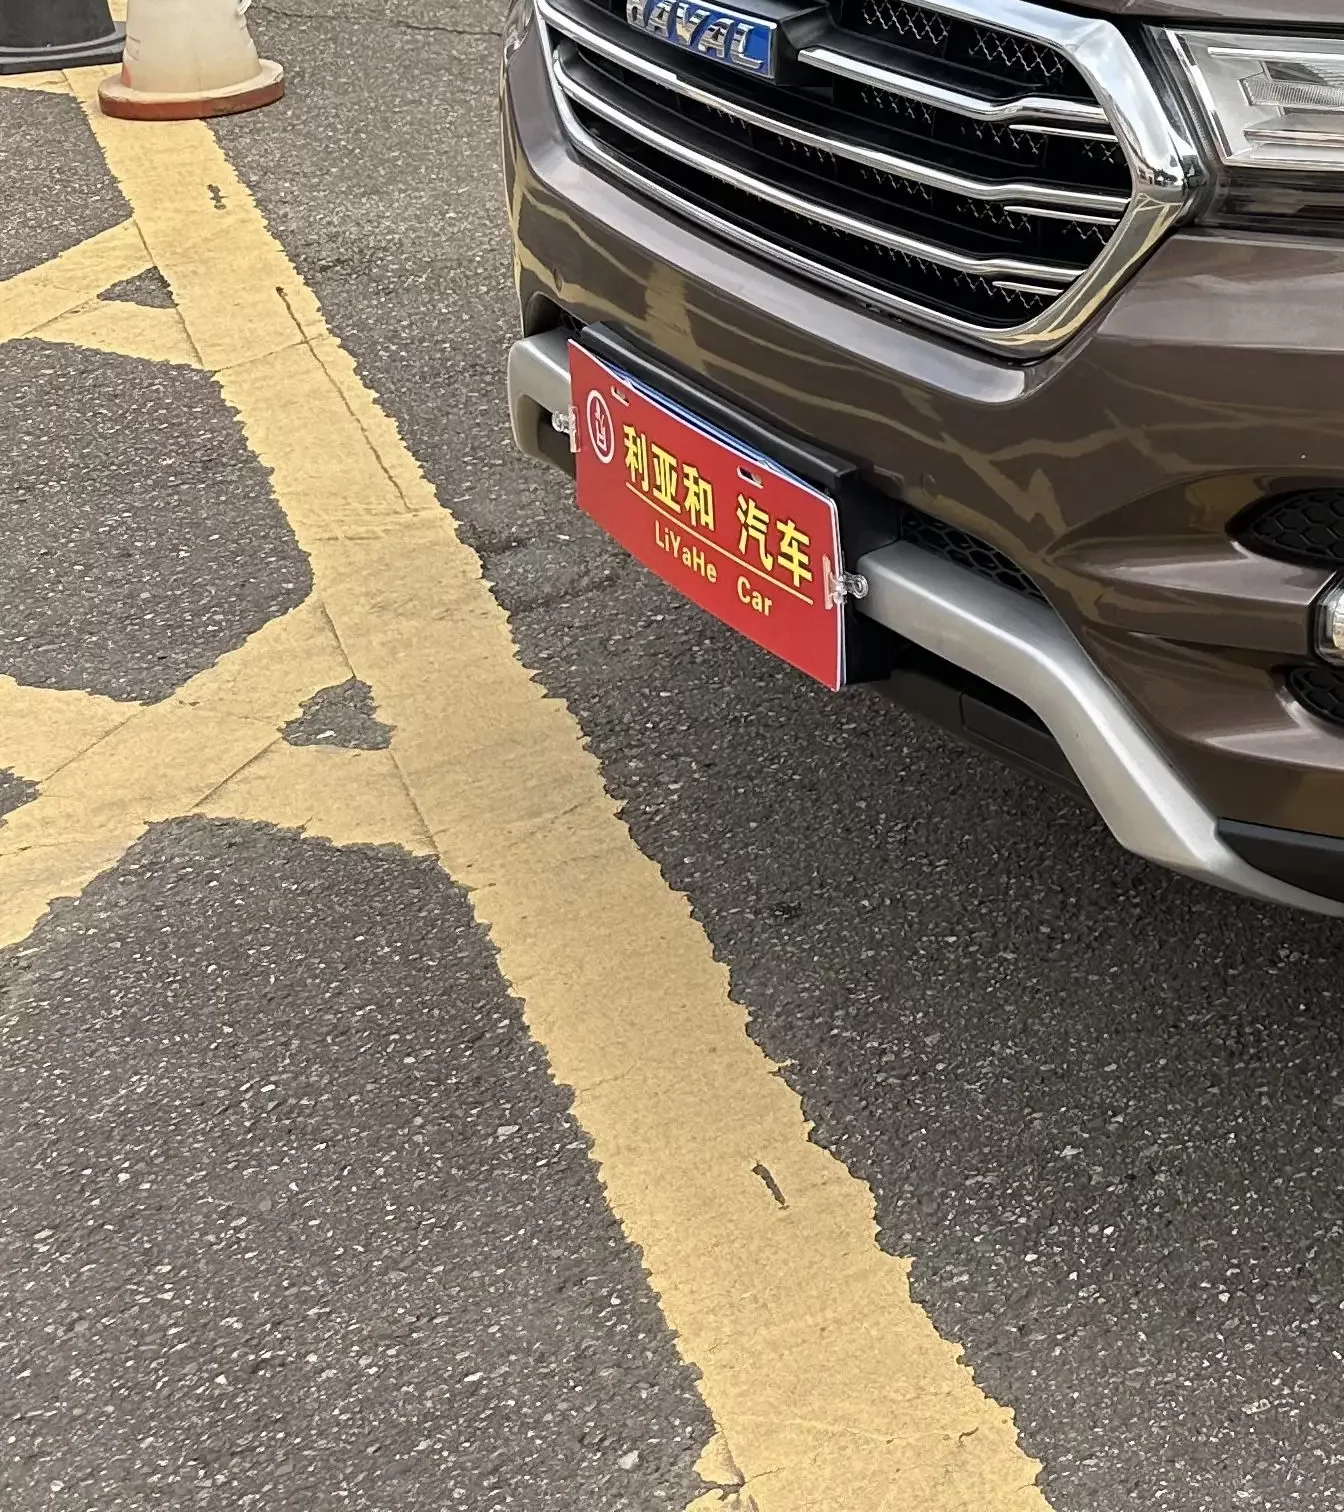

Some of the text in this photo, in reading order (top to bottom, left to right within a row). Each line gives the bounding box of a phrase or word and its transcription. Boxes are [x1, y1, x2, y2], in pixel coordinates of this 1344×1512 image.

[623, 424, 813, 587] 利亚和 汽车
[655, 520, 773, 616] LiYaHe Car
